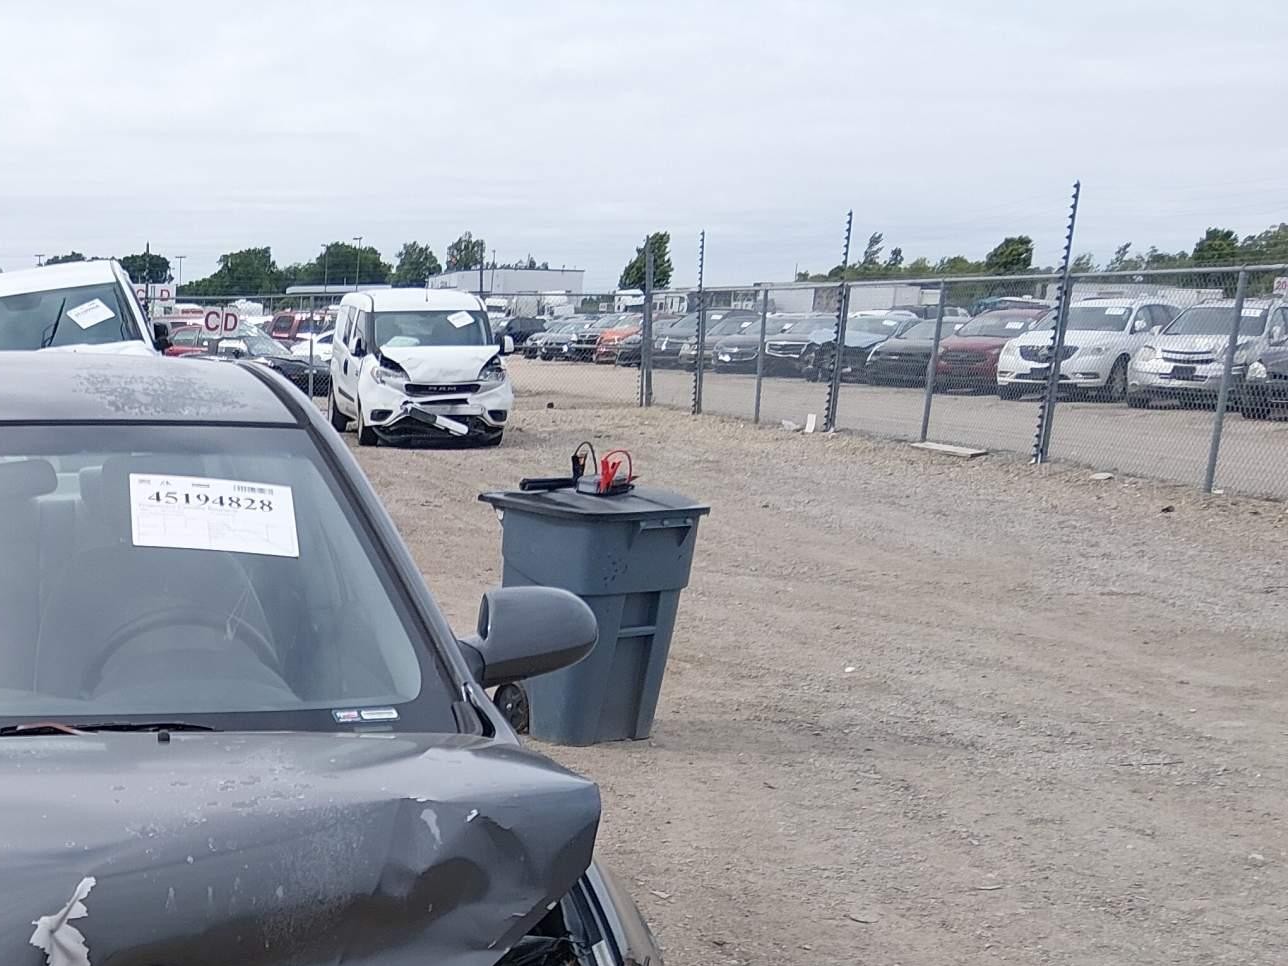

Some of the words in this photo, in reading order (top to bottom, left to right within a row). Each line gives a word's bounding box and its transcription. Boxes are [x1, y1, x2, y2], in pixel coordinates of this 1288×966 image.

[160, 289, 170, 301] D
[205, 311, 221, 332] C
[224, 313, 238, 331] D
[148, 491, 273, 512] 45194828
